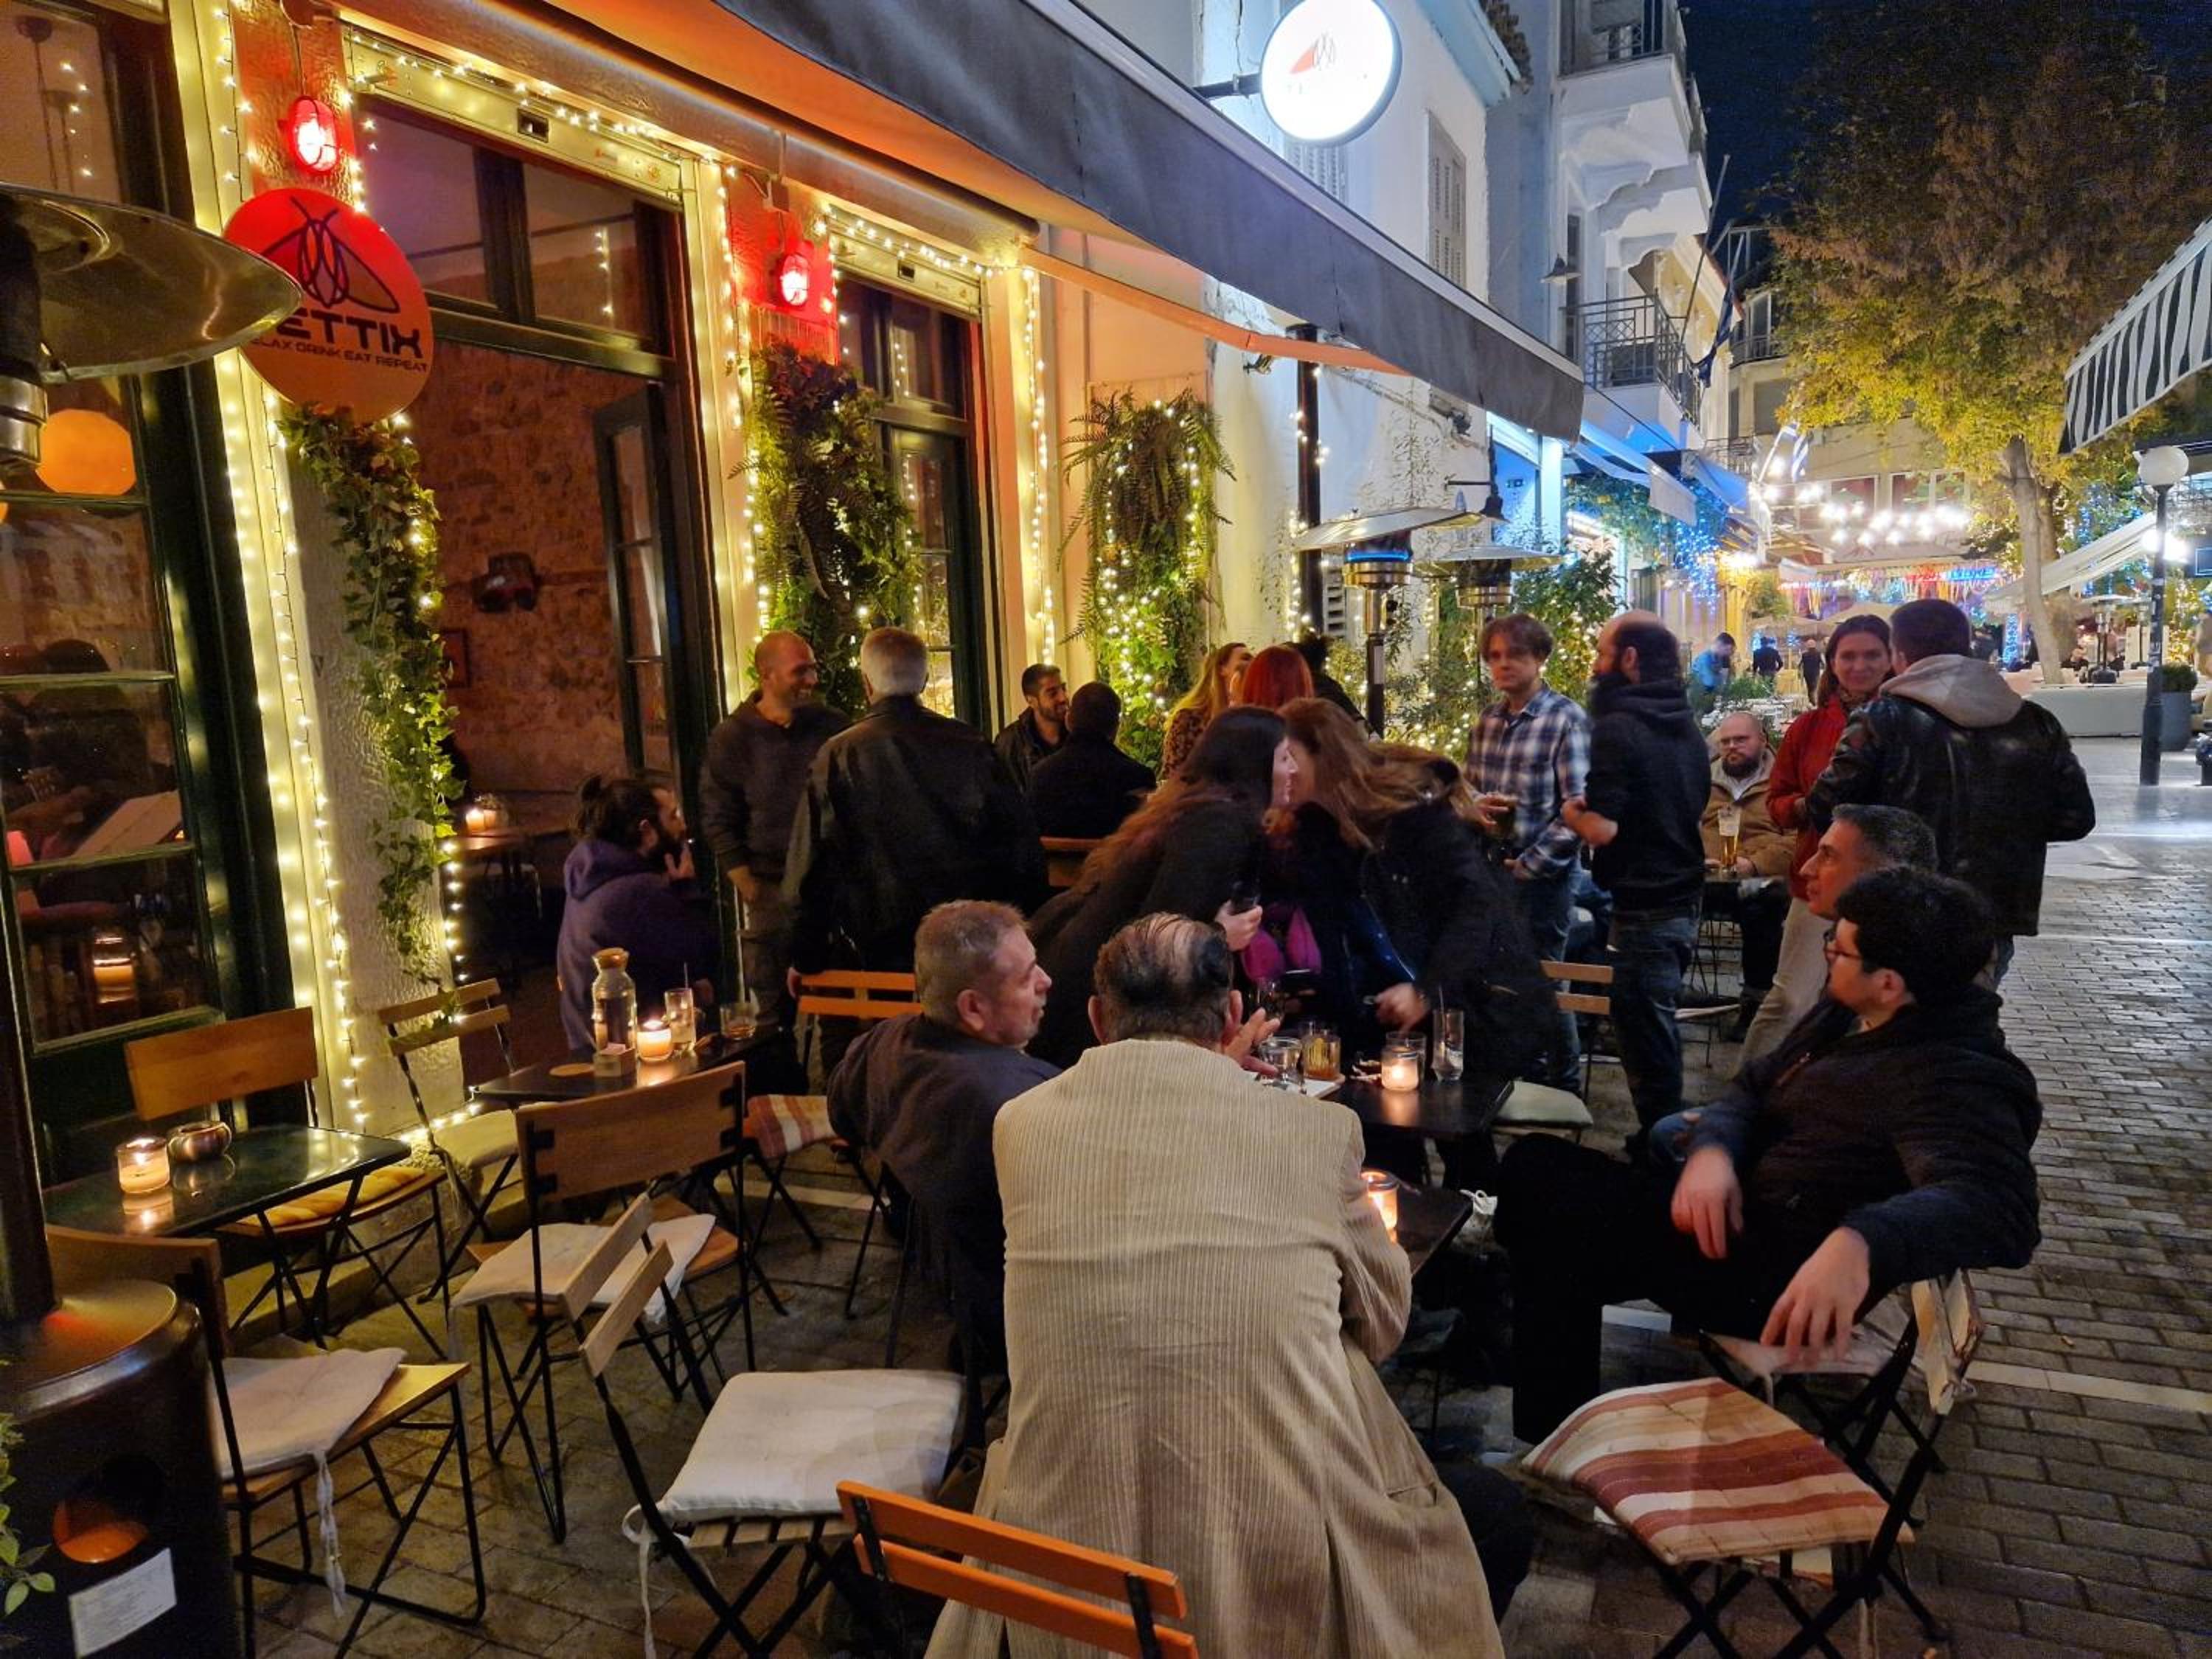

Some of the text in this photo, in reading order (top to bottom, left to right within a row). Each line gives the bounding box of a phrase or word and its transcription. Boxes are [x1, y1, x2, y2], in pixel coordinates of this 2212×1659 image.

[276, 307, 423, 358] ETTIX
[296, 343, 341, 358] DRINK
[344, 350, 372, 363] EAT
[376, 356, 428, 372] REPEAT
